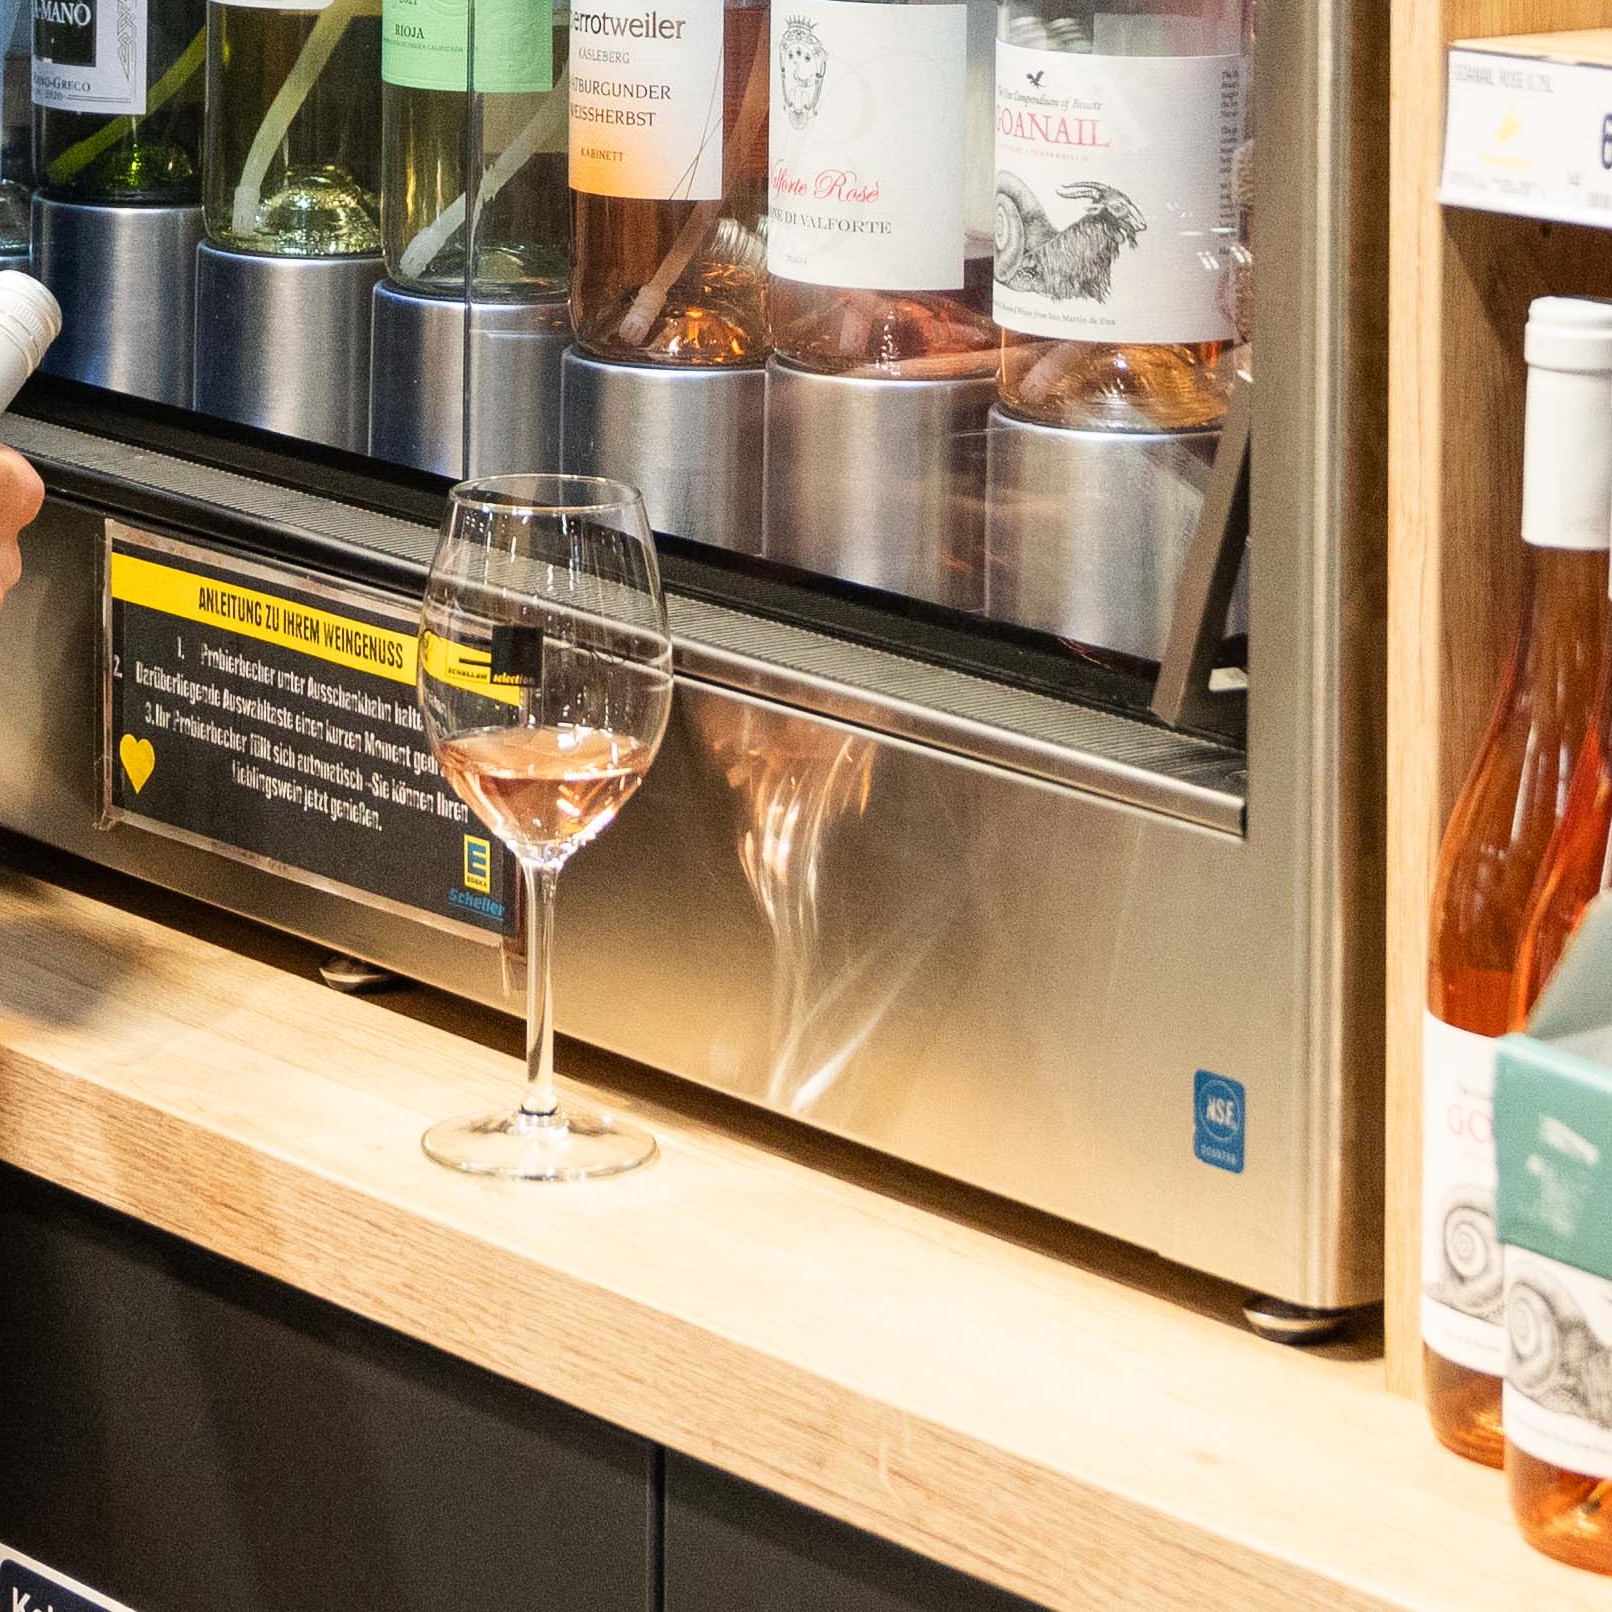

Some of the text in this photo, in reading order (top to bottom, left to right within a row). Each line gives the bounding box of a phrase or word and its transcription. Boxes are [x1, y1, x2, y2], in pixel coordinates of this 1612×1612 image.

[395, 24, 425, 40] RIOJA
[580, 147, 625, 162] KABINETT
[800, 214, 892, 234] VALFORTE
[198, 586, 403, 669] ANLEITUNG ZU IHREM WEINGENUSS
[113, 654, 411, 766] 2. Darüberliegende Auswahltaste einen kurzen Moment
[177, 636, 185, 660] 1.
[200, 642, 276, 686] Probierbecher
[277, 669, 306, 693] unter
[307, 676, 391, 722] Ausschankhahn
[173, 710, 248, 753] Probierbecher
[250, 733, 272, 759] füllt
[273, 743, 295, 769] sich
[297, 754, 364, 792] automatisch
[391, 778, 434, 815] können
[437, 791, 469, 824] Ihren
[232, 763, 383, 832] Lieblingswein jetzt genießen.
[450, 887, 505, 917] Scheller
